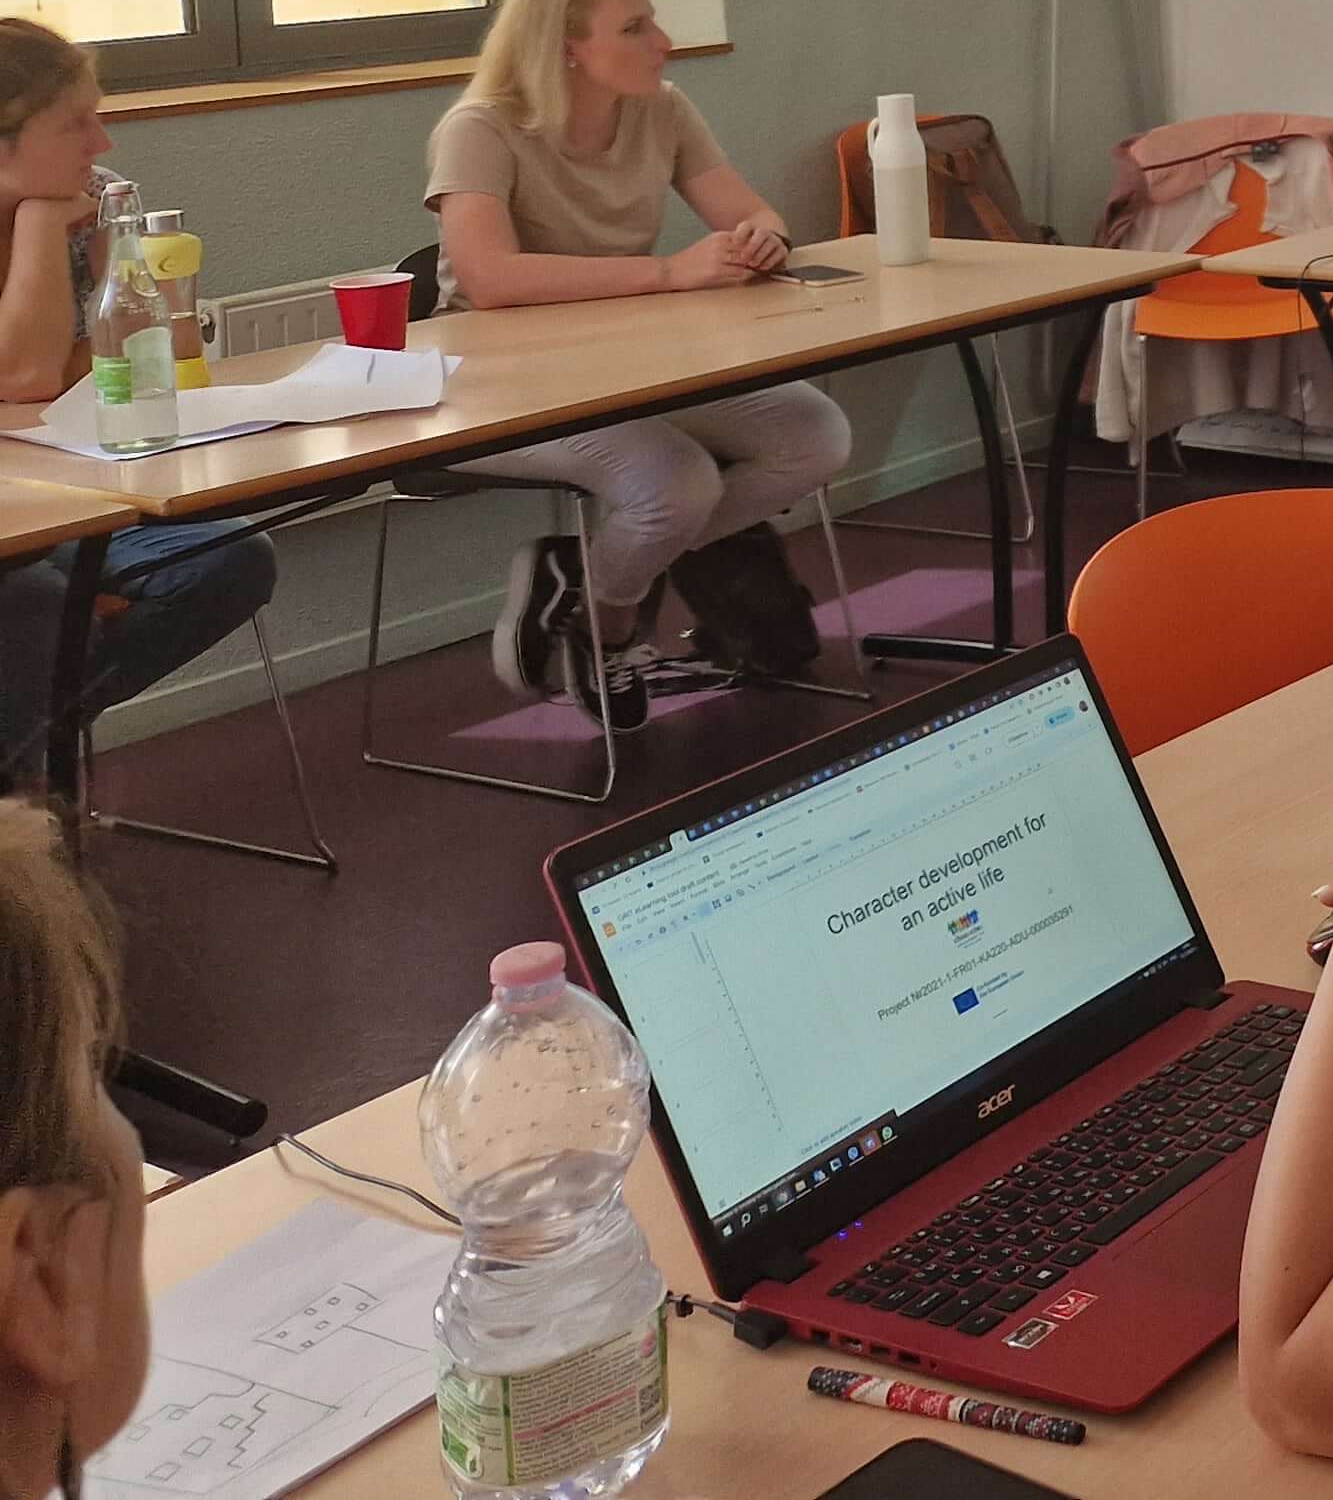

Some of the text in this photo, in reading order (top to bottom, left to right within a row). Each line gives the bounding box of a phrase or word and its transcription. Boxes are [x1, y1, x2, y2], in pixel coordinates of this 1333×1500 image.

[633, 894, 667, 916] eLearning
[666, 887, 681, 899] tool
[679, 880, 696, 893] draft
[695, 869, 721, 886] content
[825, 810, 1048, 936] Character development for
[899, 862, 1005, 932] an active life
[877, 994, 912, 1023] Project
[977, 1083, 1017, 1120] acer
